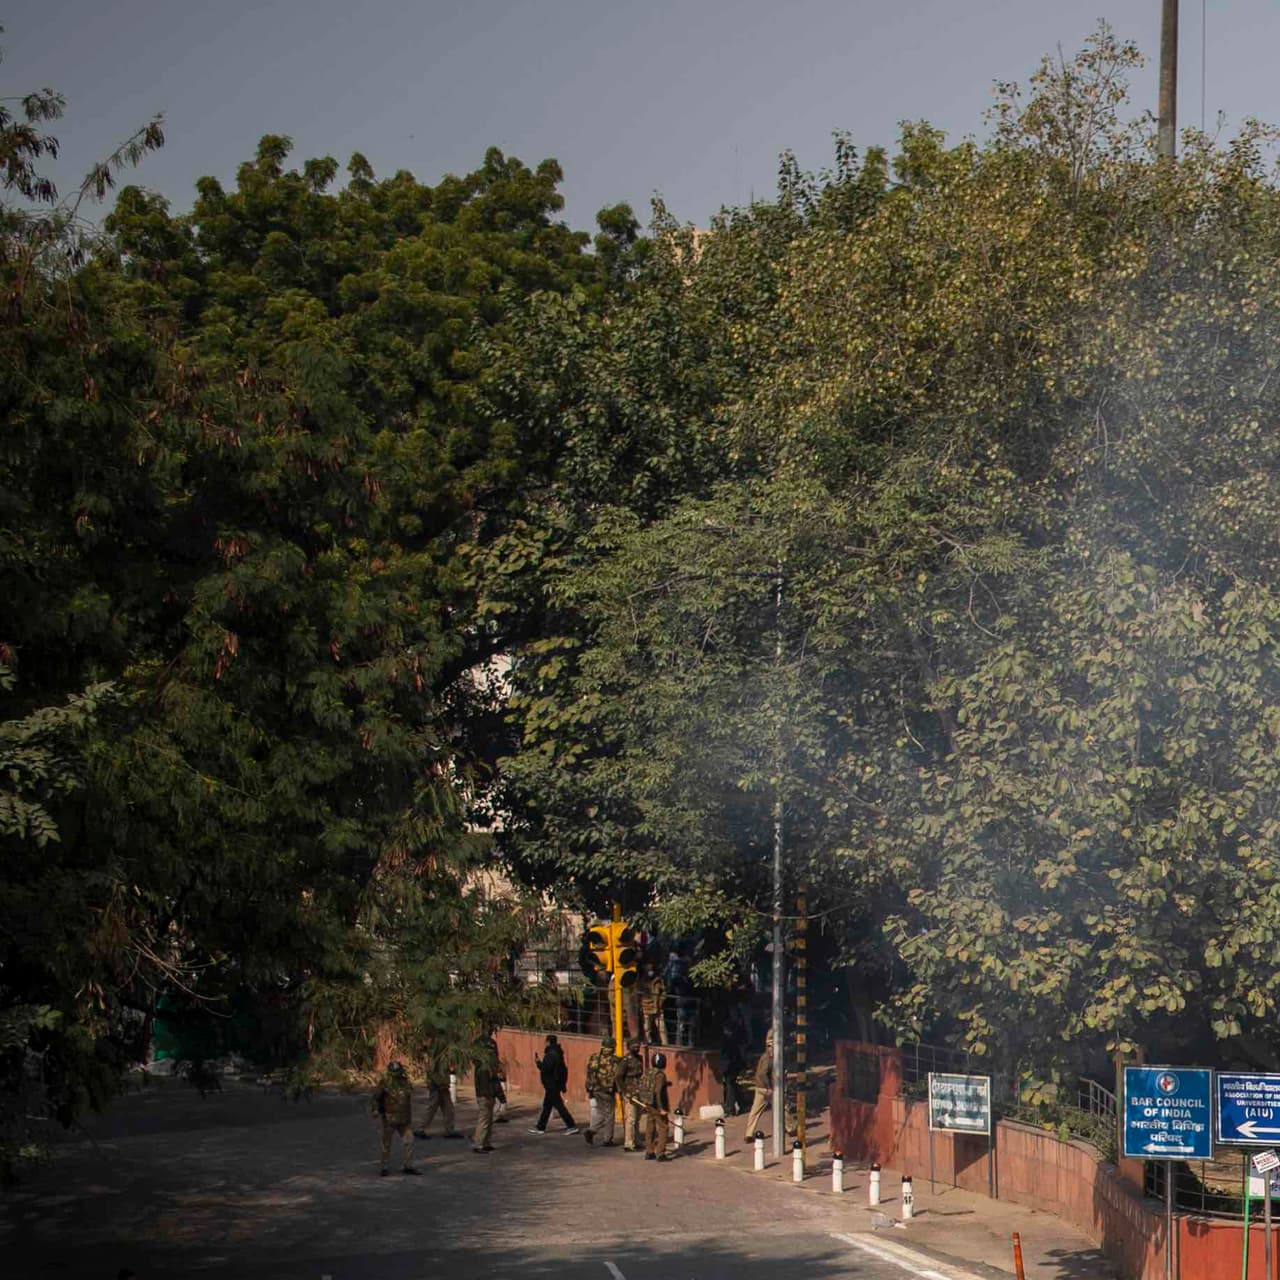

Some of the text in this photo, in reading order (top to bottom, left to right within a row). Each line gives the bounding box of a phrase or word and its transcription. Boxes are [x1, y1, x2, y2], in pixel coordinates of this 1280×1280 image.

[1131, 1097, 1205, 1108] BAR COUNCIL
[1143, 1109, 1192, 1118] OF INDIA
[1245, 1107, 1273, 1119] (AIU)
